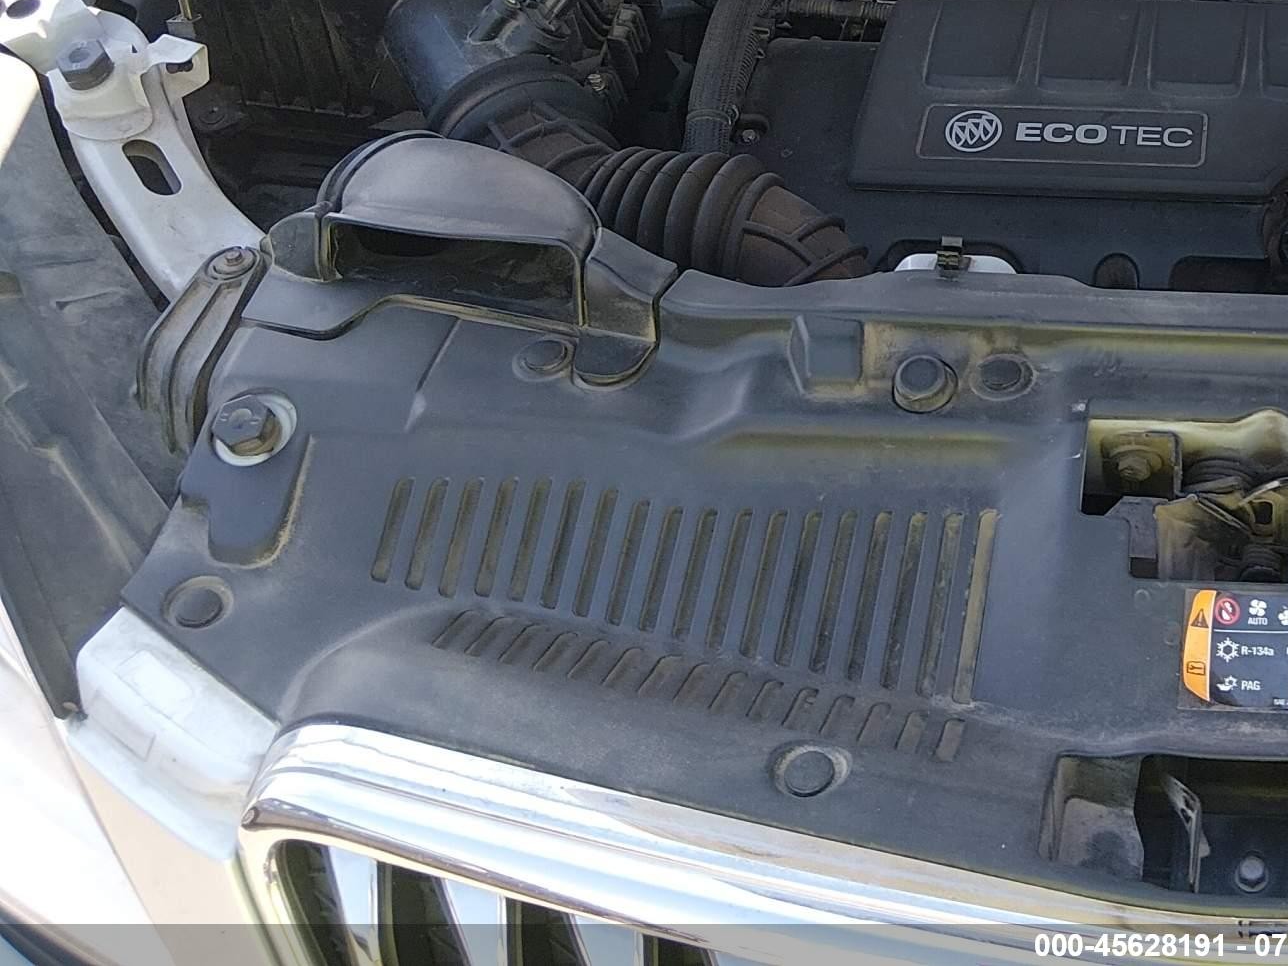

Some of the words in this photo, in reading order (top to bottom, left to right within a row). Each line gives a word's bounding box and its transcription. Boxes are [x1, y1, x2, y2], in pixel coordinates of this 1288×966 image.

[1015, 121, 1193, 148] ECOTEC
[1247, 617, 1268, 625] AUTO
[1240, 645, 1275, 656] R-134a
[1240, 680, 1261, 691] PAG
